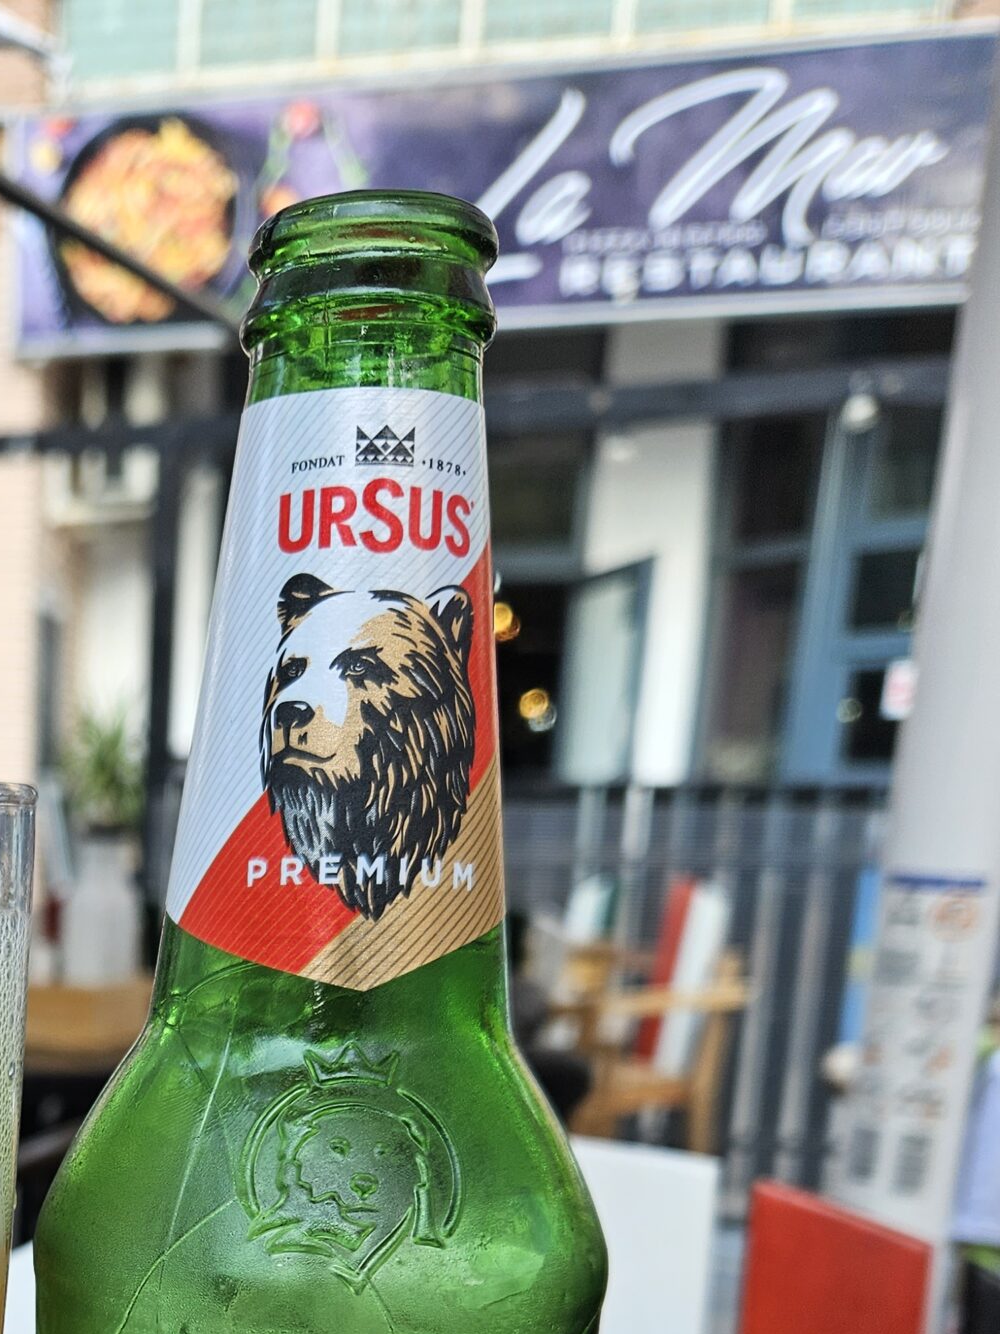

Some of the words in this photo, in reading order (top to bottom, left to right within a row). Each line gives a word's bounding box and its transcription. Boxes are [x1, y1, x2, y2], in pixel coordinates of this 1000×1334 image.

[291, 455, 346, 474] FONDAT
[278, 478, 472, 558] URSUS
[247, 852, 474, 892] PREMIUM
